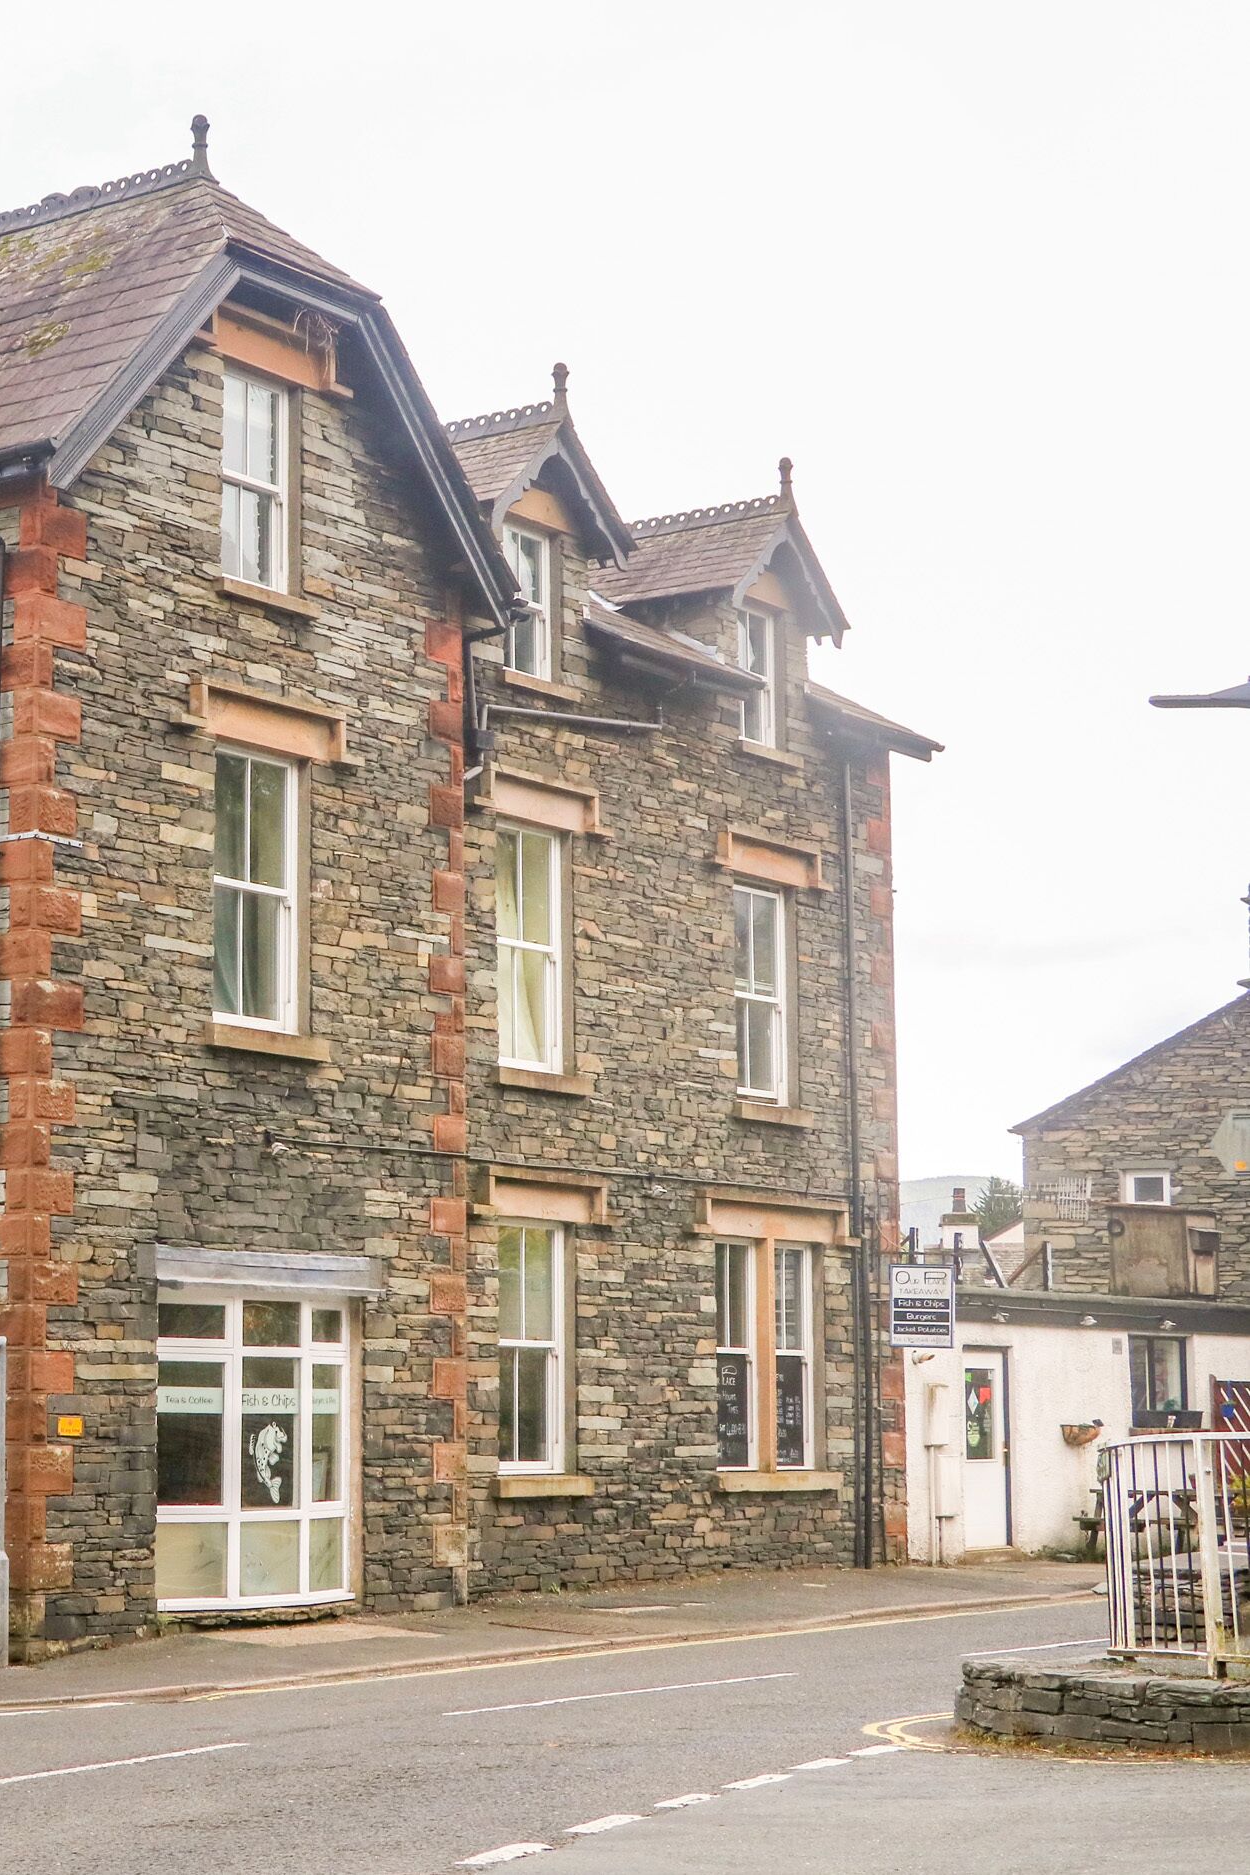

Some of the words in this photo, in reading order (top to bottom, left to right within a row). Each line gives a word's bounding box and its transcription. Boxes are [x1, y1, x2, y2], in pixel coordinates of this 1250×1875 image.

[898, 1299, 914, 1307] Fish
[923, 1299, 945, 1308] Chips
[906, 1312, 937, 1321] Burgers
[917, 1326, 948, 1334] Potatoes
[165, 1395, 180, 1404] Tea
[188, 1395, 214, 1405] Coffee
[241, 1393, 258, 1407] Fish
[262, 1396, 268, 1407] &
[271, 1393, 296, 1409] Chips
